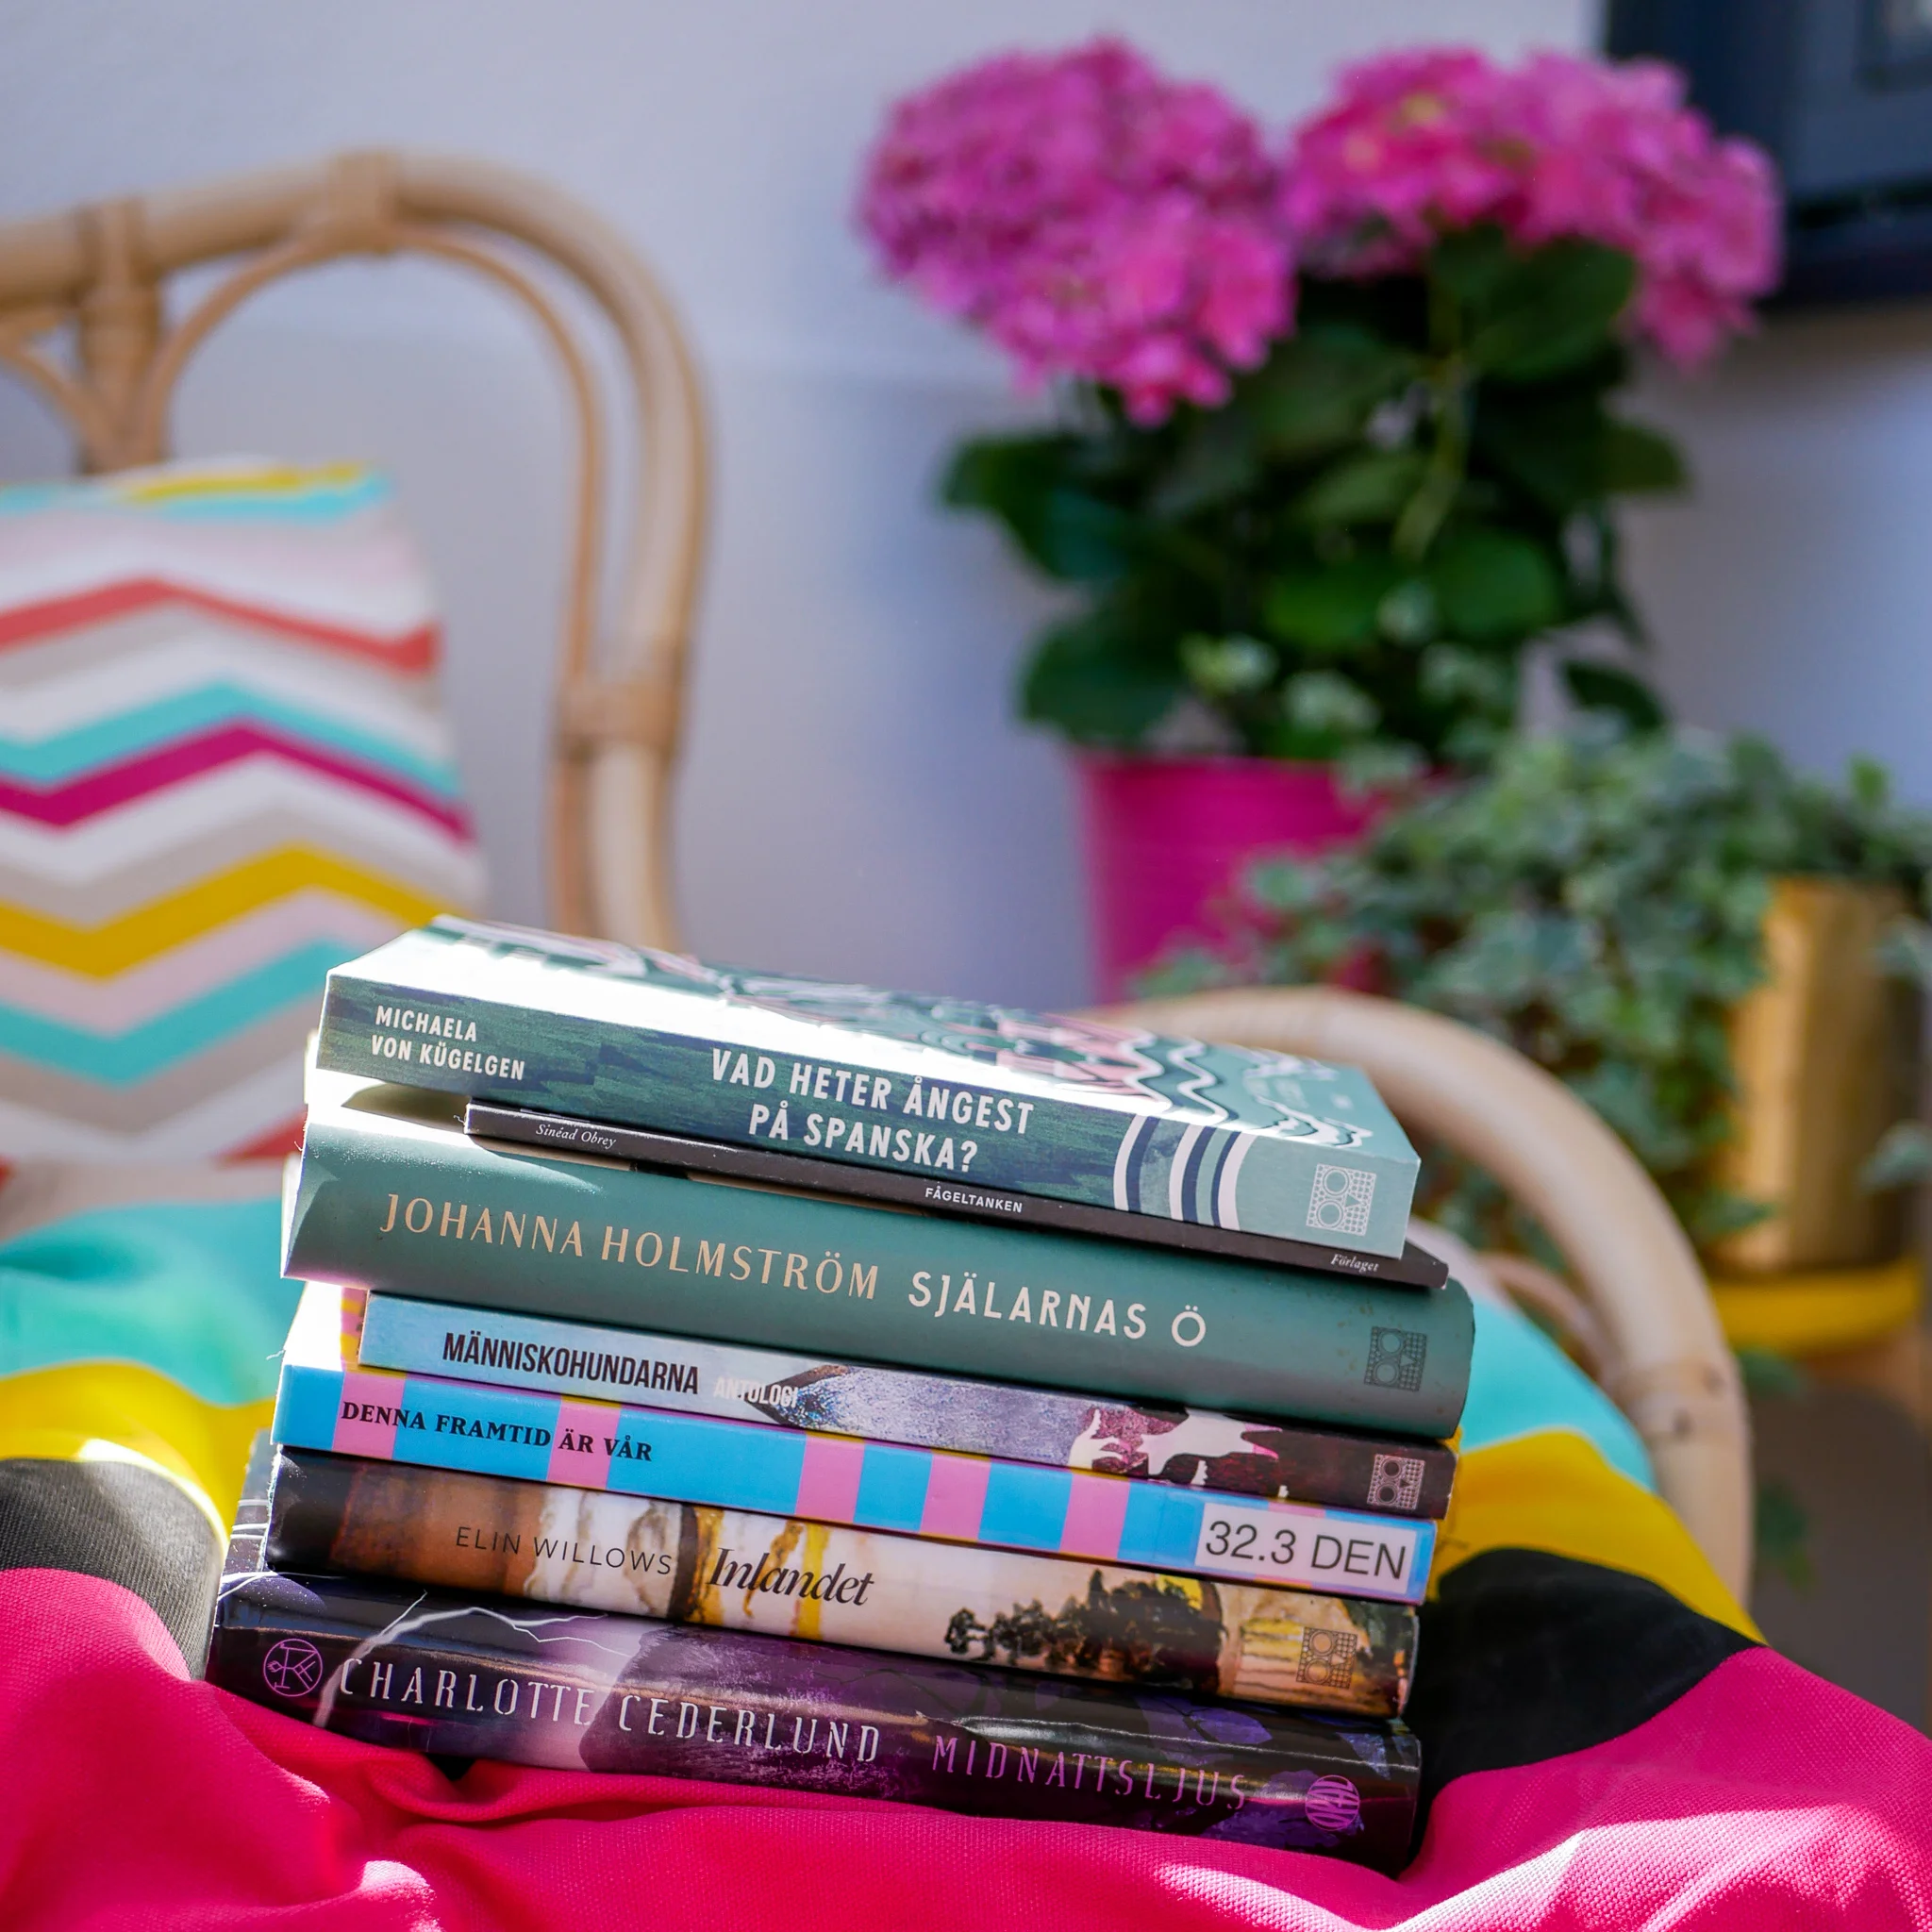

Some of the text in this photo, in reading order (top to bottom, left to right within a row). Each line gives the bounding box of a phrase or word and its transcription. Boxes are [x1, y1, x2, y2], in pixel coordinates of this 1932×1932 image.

[375, 1005, 477, 1042] MICHAELA
[371, 1034, 525, 1081] VON KÜGELGEN
[711, 1047, 1034, 1134] VAD HETER ÅNGEST
[535, 1123, 617, 1150] Sinéad Obrey
[748, 1100, 978, 1173] PÅ SPANSKA?
[924, 1185, 1024, 1213] FÅGELTANKEN
[379, 1193, 878, 1301] JOHANNA HOLMSTRÖM
[1330, 1253, 1380, 1274] Förlaget
[908, 1270, 1207, 1348] SJÄLARNAS Ö
[442, 1331, 700, 1395] MÄNNISKOHUNDARNA
[713, 1376, 799, 1408] ANTOLOGI
[341, 1401, 653, 1463] DENNA FRAMTID ÄR VÅR
[456, 1525, 673, 1575] ELIN WILLOWS
[705, 1547, 874, 1606] Inlandet
[1206, 1520, 1407, 1580] 32.3 DEN
[339, 1657, 881, 1763] CHARLOTTE CEDERLUND
[932, 1734, 1246, 1811] MIDNATTSLJUS
